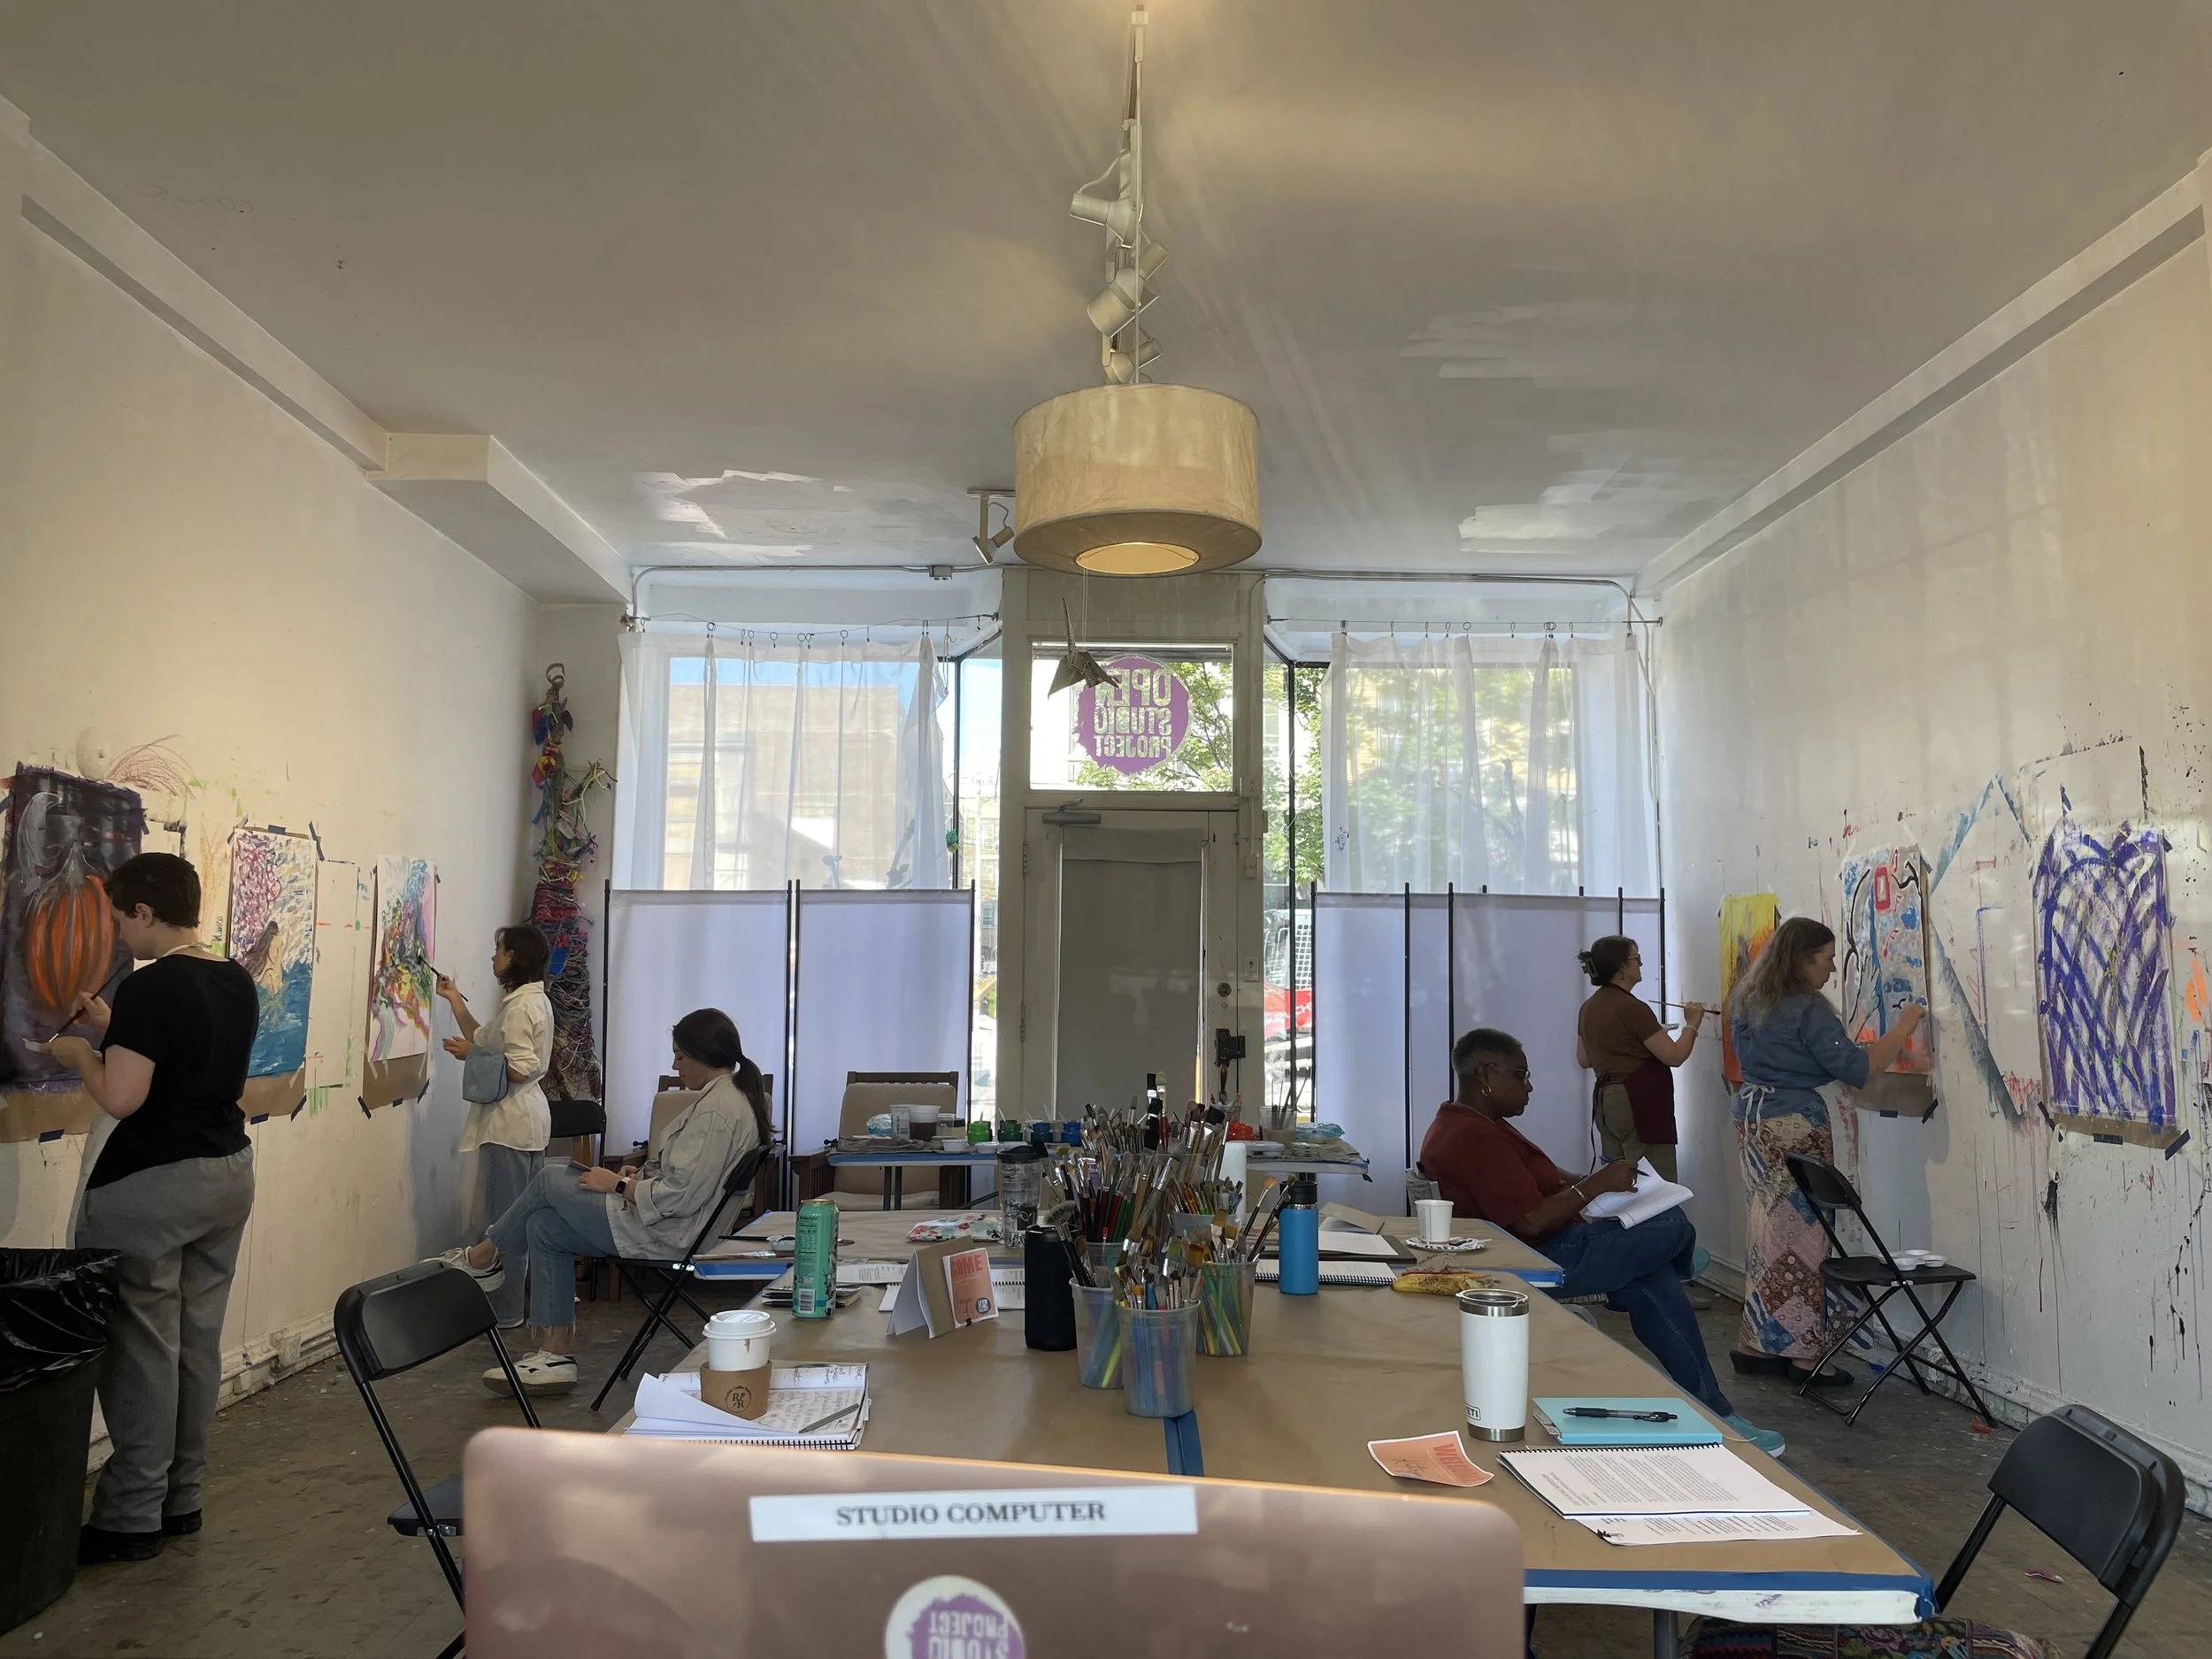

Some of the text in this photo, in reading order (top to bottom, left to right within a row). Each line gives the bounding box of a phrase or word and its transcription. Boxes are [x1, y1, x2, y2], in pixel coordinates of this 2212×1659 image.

[836, 1500, 1108, 1526] STUDIO COMPUTER
[929, 1609, 1010, 1641] PROJECT
